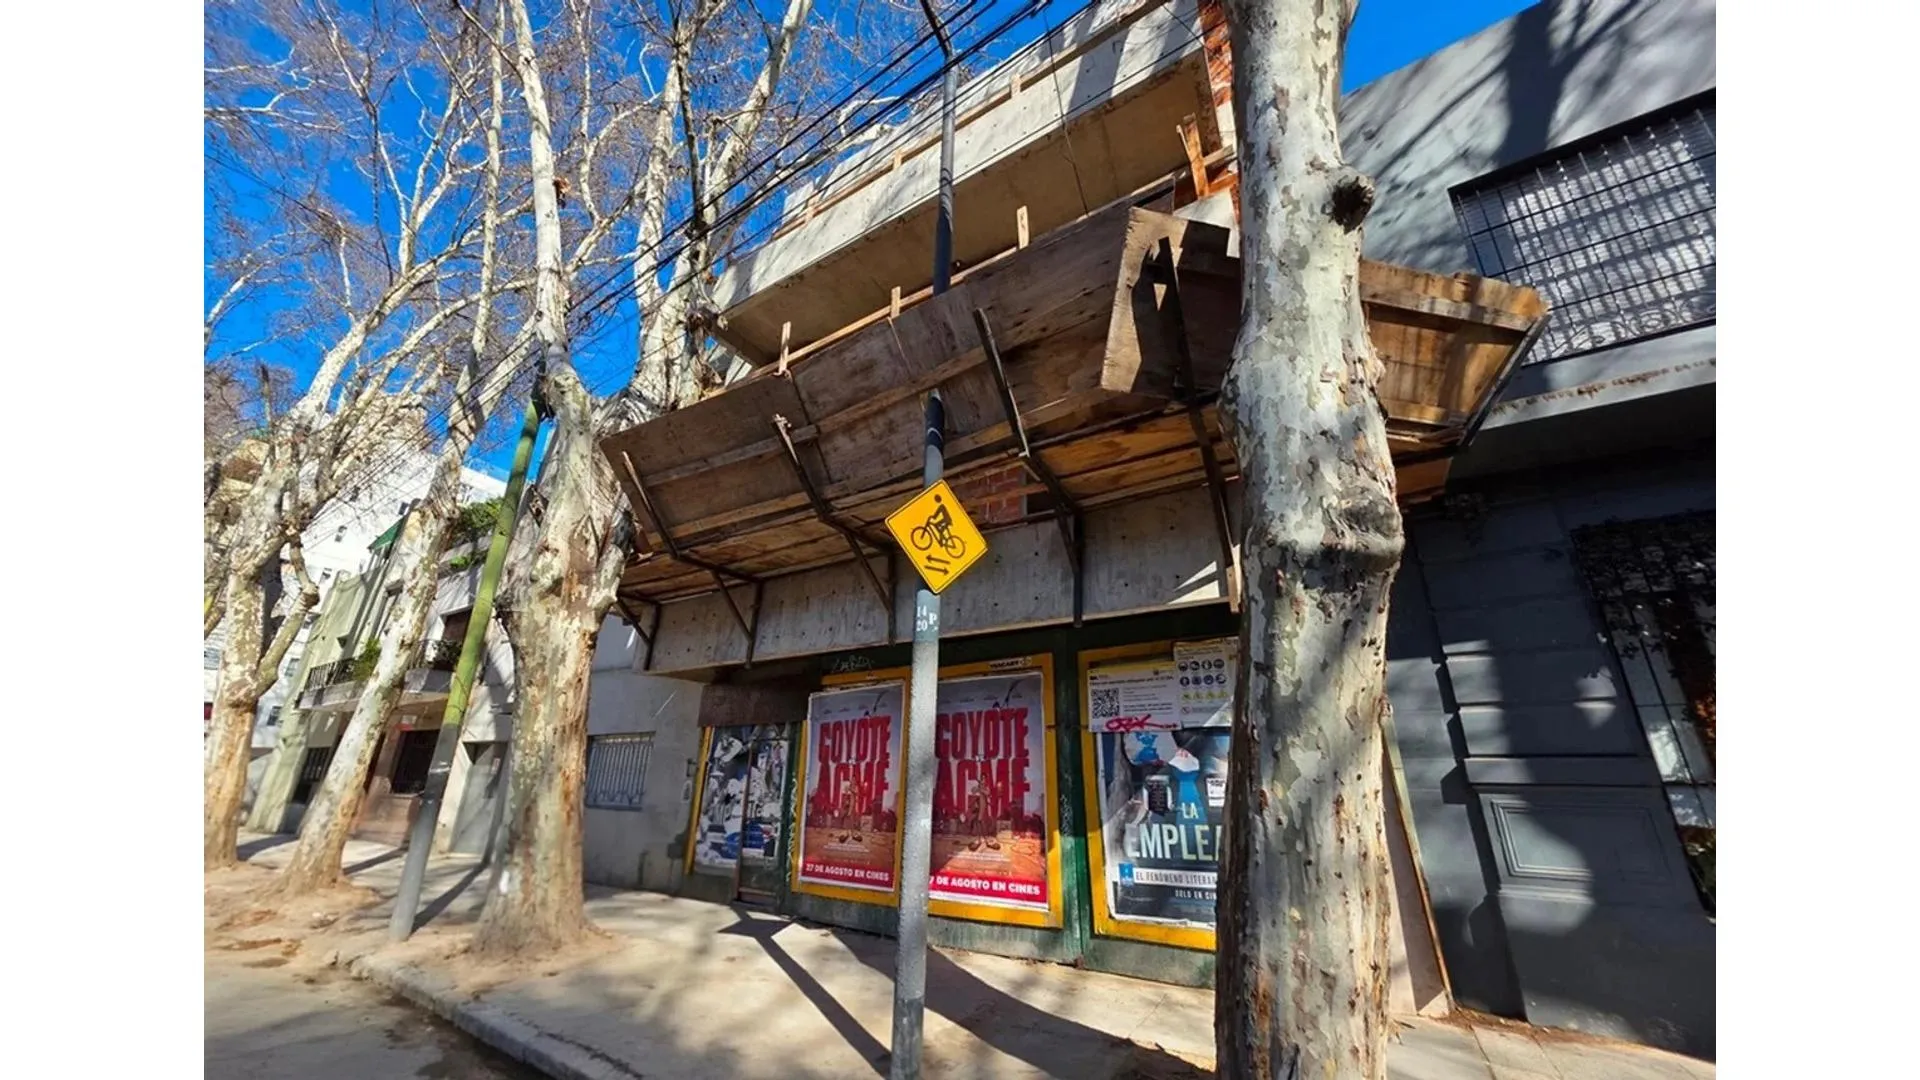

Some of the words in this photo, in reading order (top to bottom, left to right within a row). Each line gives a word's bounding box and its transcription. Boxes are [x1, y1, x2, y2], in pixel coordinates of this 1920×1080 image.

[819, 715, 891, 763] COYOTE
[935, 707, 1029, 760] COYOTE
[816, 761, 889, 816] ACME
[933, 758, 1030, 820] ACME
[1182, 802, 1199, 819] LA
[1123, 823, 1222, 861] EMPLE
[806, 863, 814, 872] 27
[824, 866, 853, 877] AGOSTO
[855, 869, 865, 878] EN
[866, 870, 889, 881] CINES
[936, 876, 949, 885] DE
[951, 878, 990, 890] AGOSTO
[992, 882, 1006, 892] EN
[1008, 883, 1040, 895] CINES
[1135, 872, 1144, 881] EL
